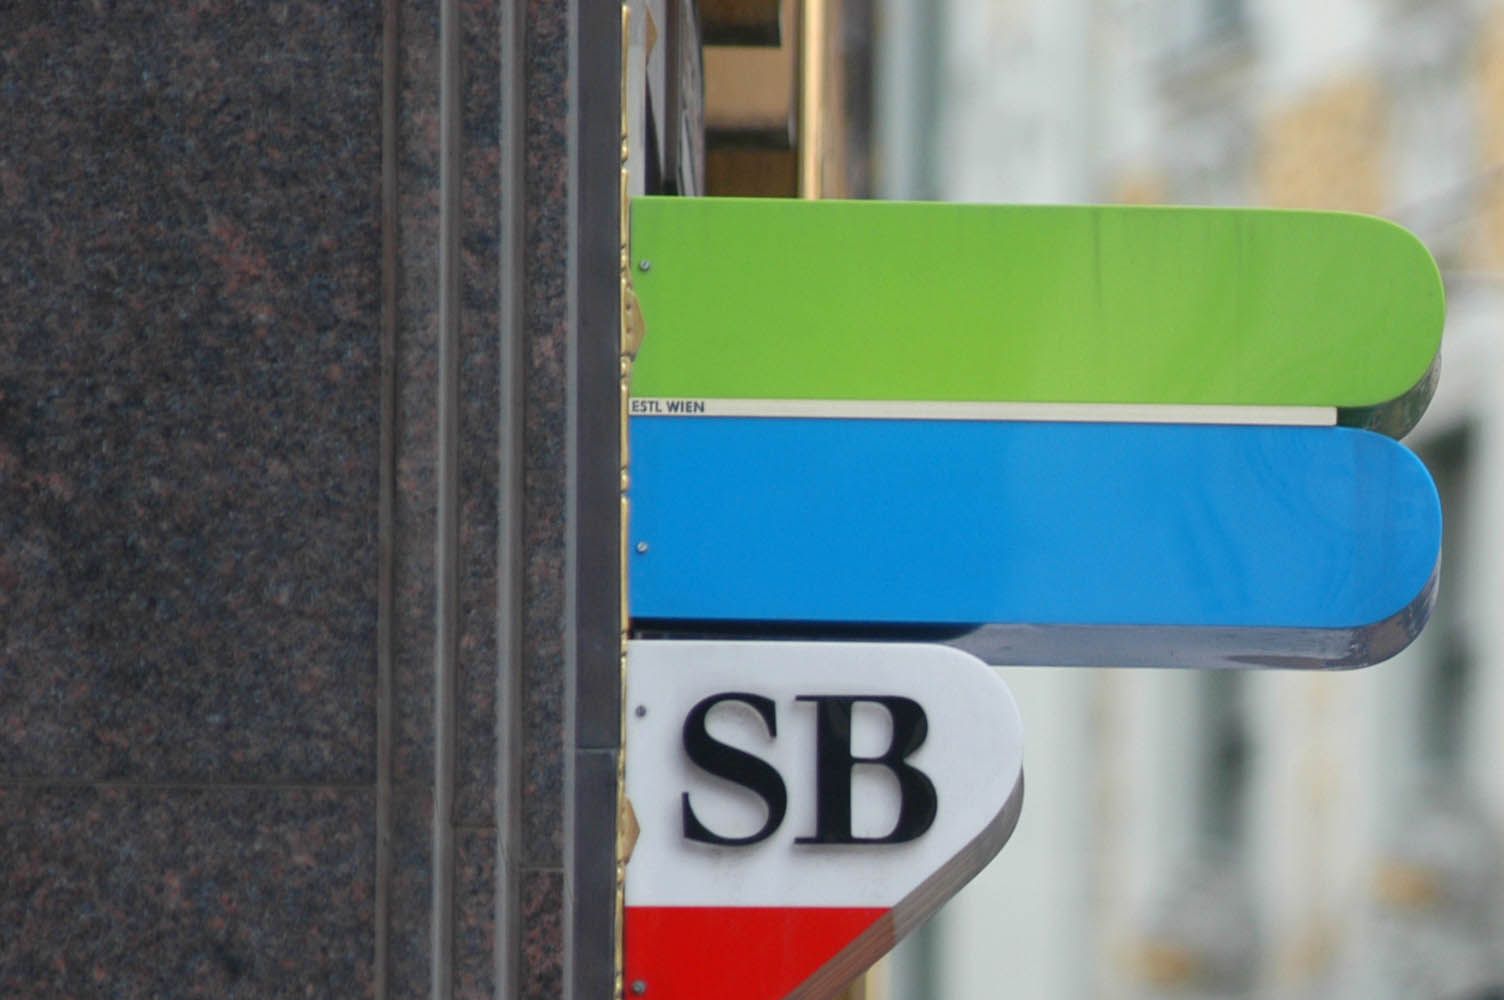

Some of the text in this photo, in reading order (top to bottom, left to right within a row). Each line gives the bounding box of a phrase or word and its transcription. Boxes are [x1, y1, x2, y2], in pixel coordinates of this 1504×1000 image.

[631, 400, 704, 413] ESTL WIEN
[682, 692, 939, 847] SB
